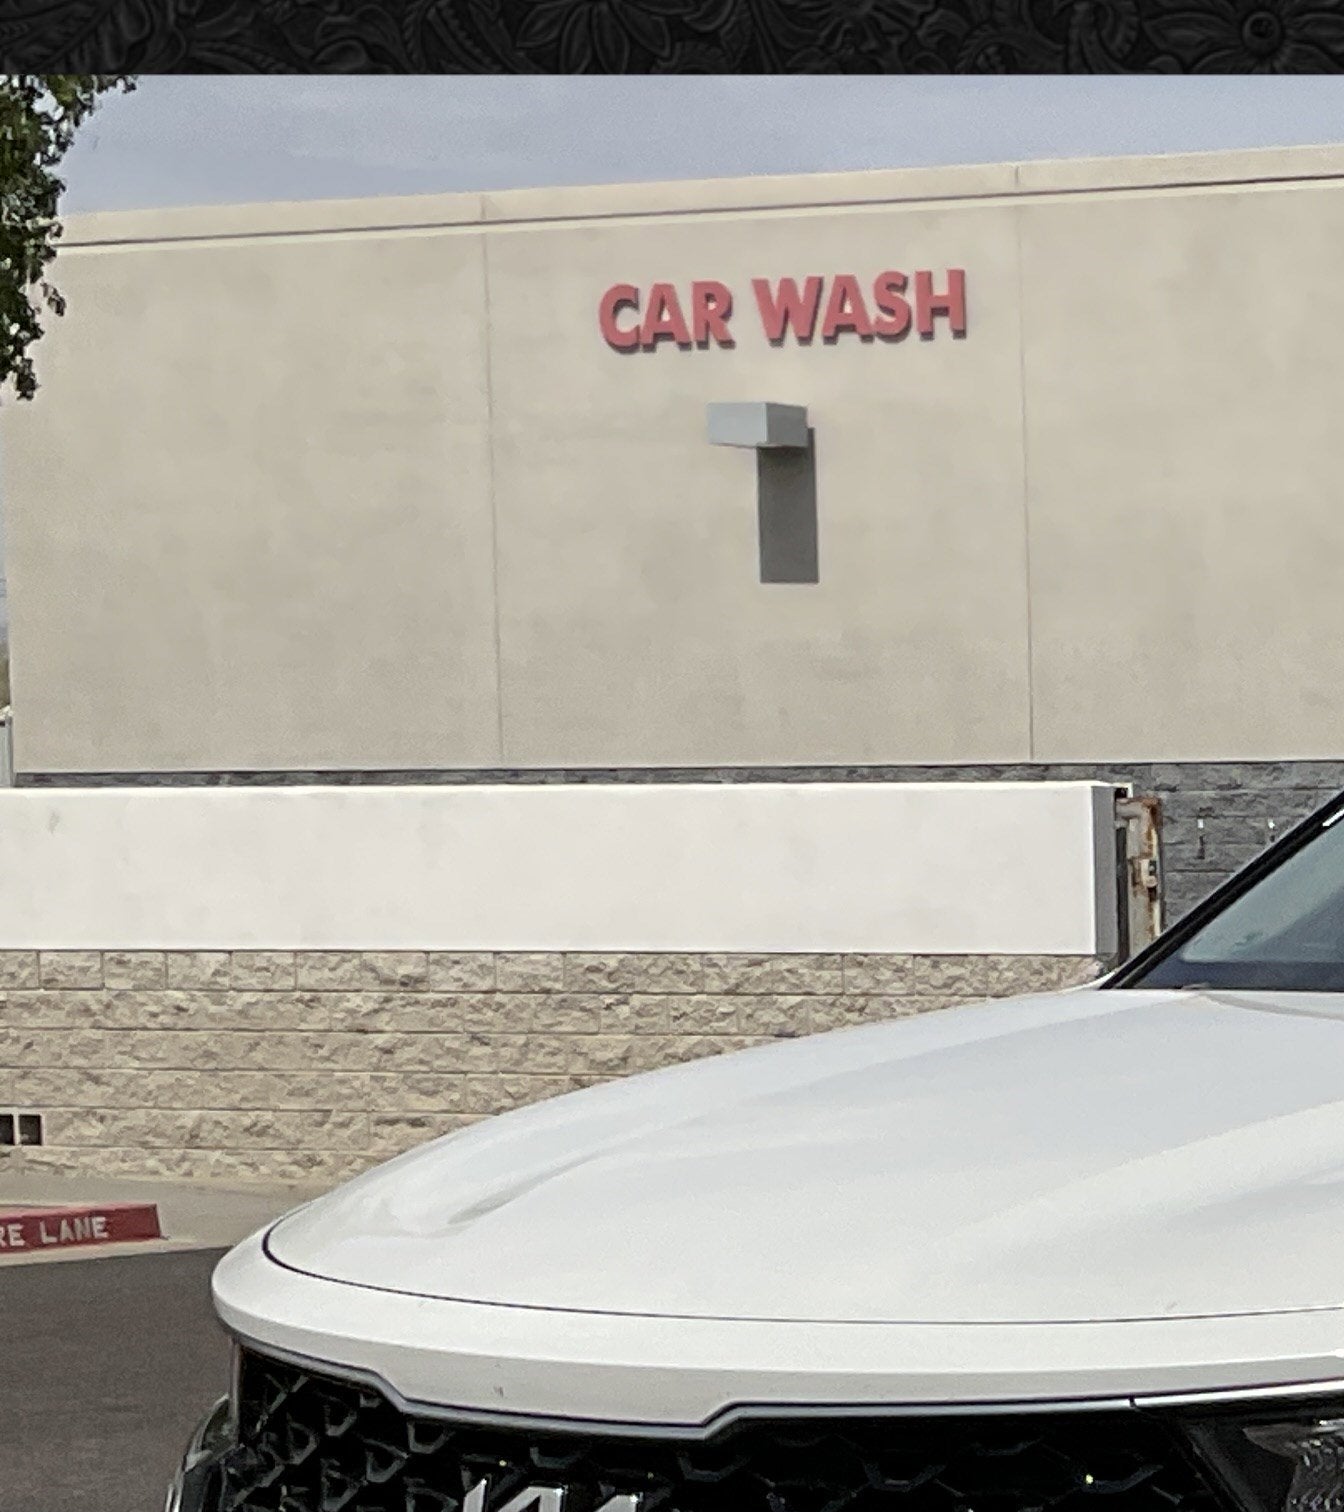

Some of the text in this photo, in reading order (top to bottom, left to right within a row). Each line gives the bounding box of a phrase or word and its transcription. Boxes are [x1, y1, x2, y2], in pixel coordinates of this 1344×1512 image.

[599, 268, 966, 352] CAR WASH
[39, 1216, 108, 1245] LANE
